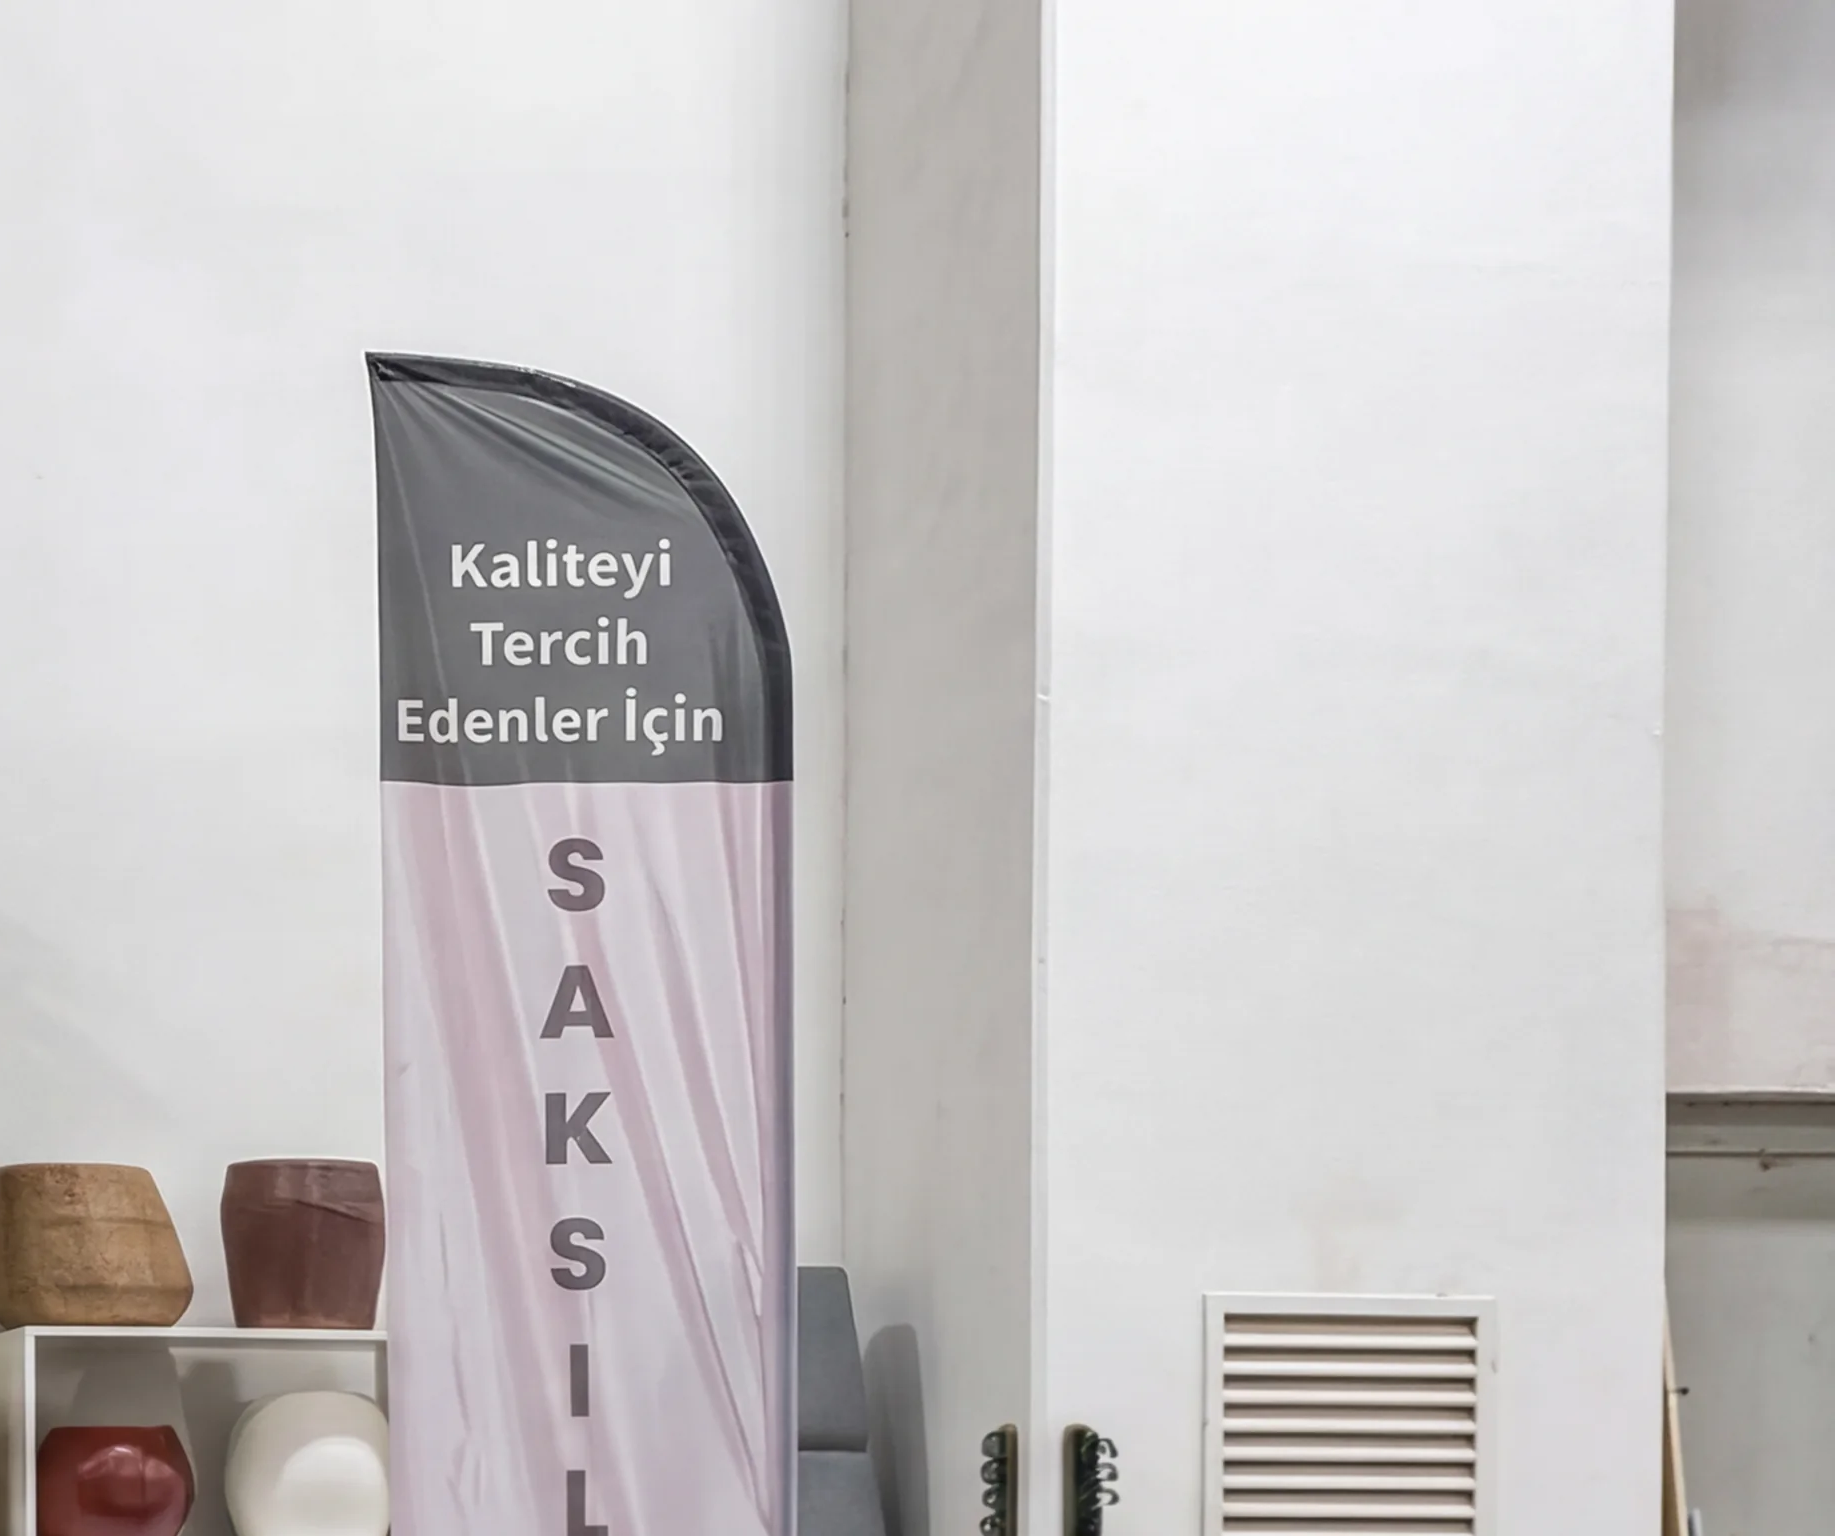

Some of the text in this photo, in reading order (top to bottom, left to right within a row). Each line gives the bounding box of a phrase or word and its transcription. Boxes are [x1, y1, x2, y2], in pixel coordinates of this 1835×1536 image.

[450, 538, 672, 599] Kaliteyi
[470, 616, 648, 666] Tercih
[397, 687, 723, 756] Edenler İçin
